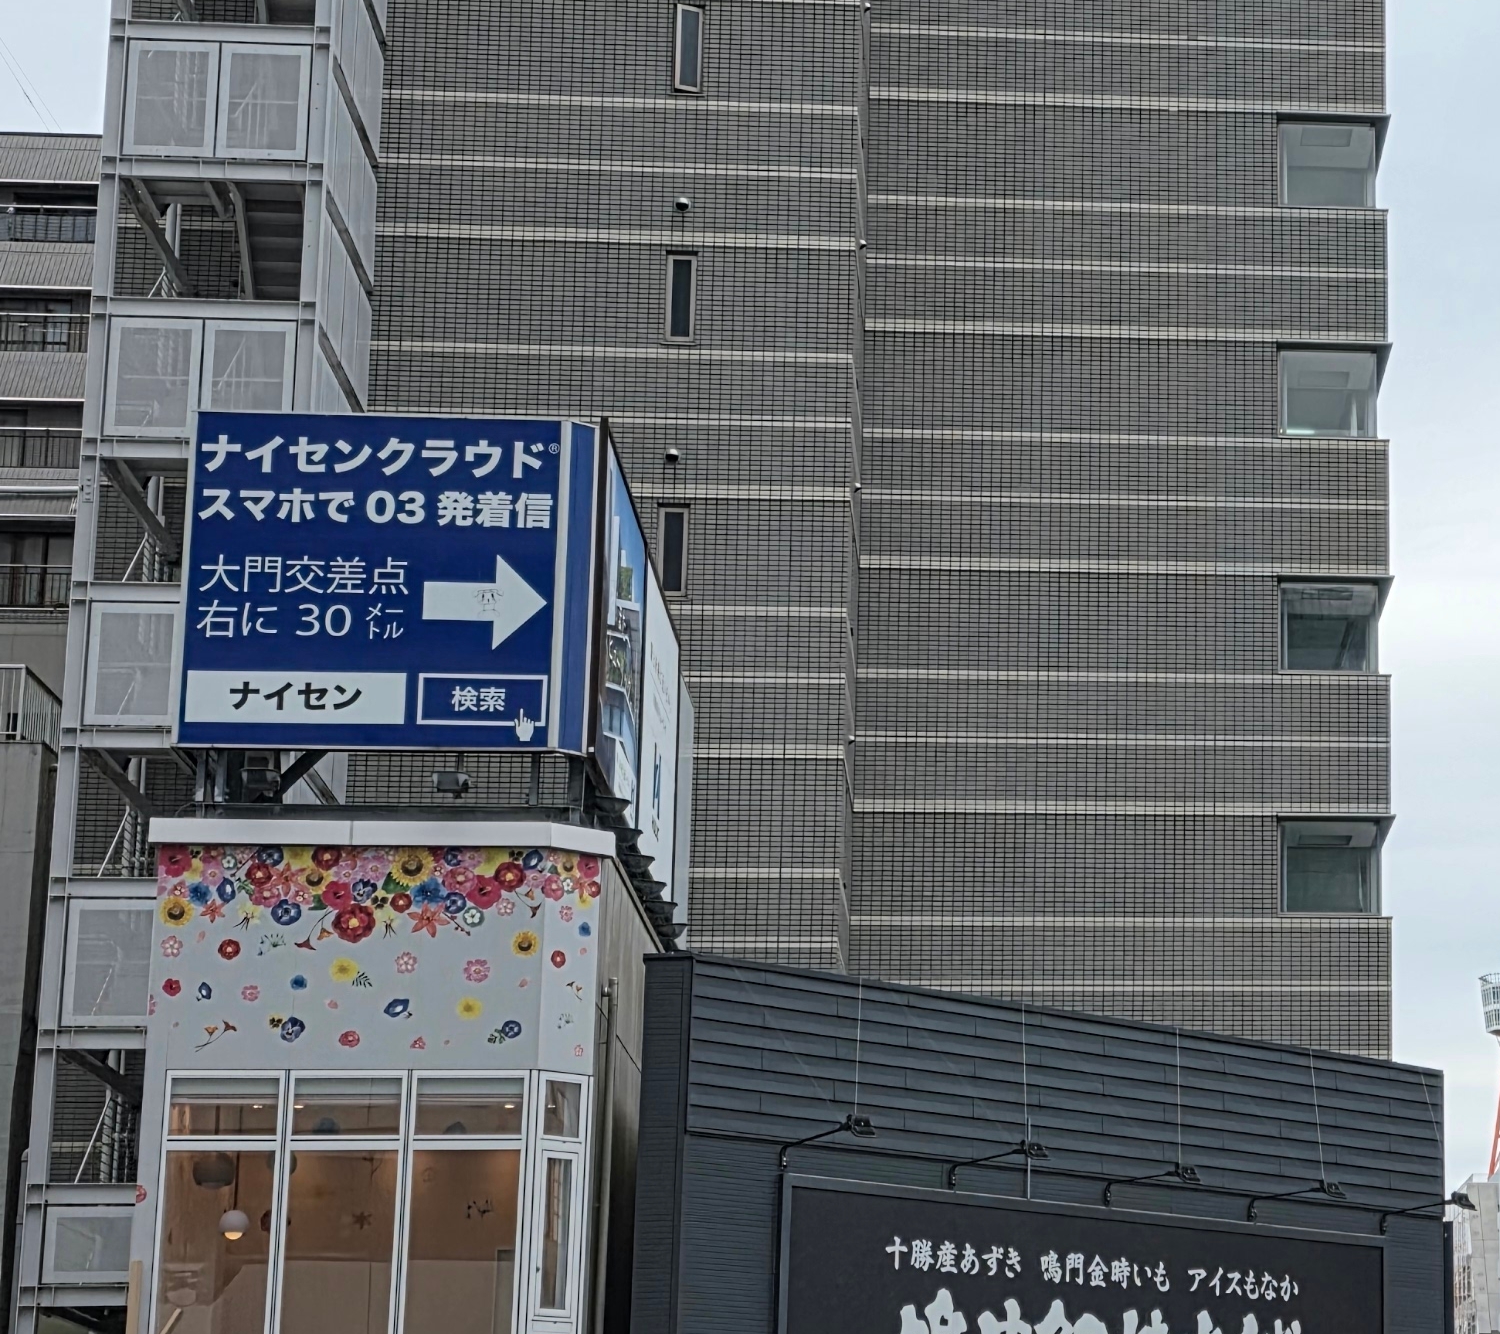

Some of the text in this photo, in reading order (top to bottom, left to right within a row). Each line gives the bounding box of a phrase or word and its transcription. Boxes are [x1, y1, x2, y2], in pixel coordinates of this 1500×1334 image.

[199, 554, 409, 595] 大門交差点
[229, 680, 362, 711] ナイセン
[451, 685, 506, 713] 検索
[885, 1236, 1299, 1302] 十勝産あずき 鳴門金時いも アイスもなか
